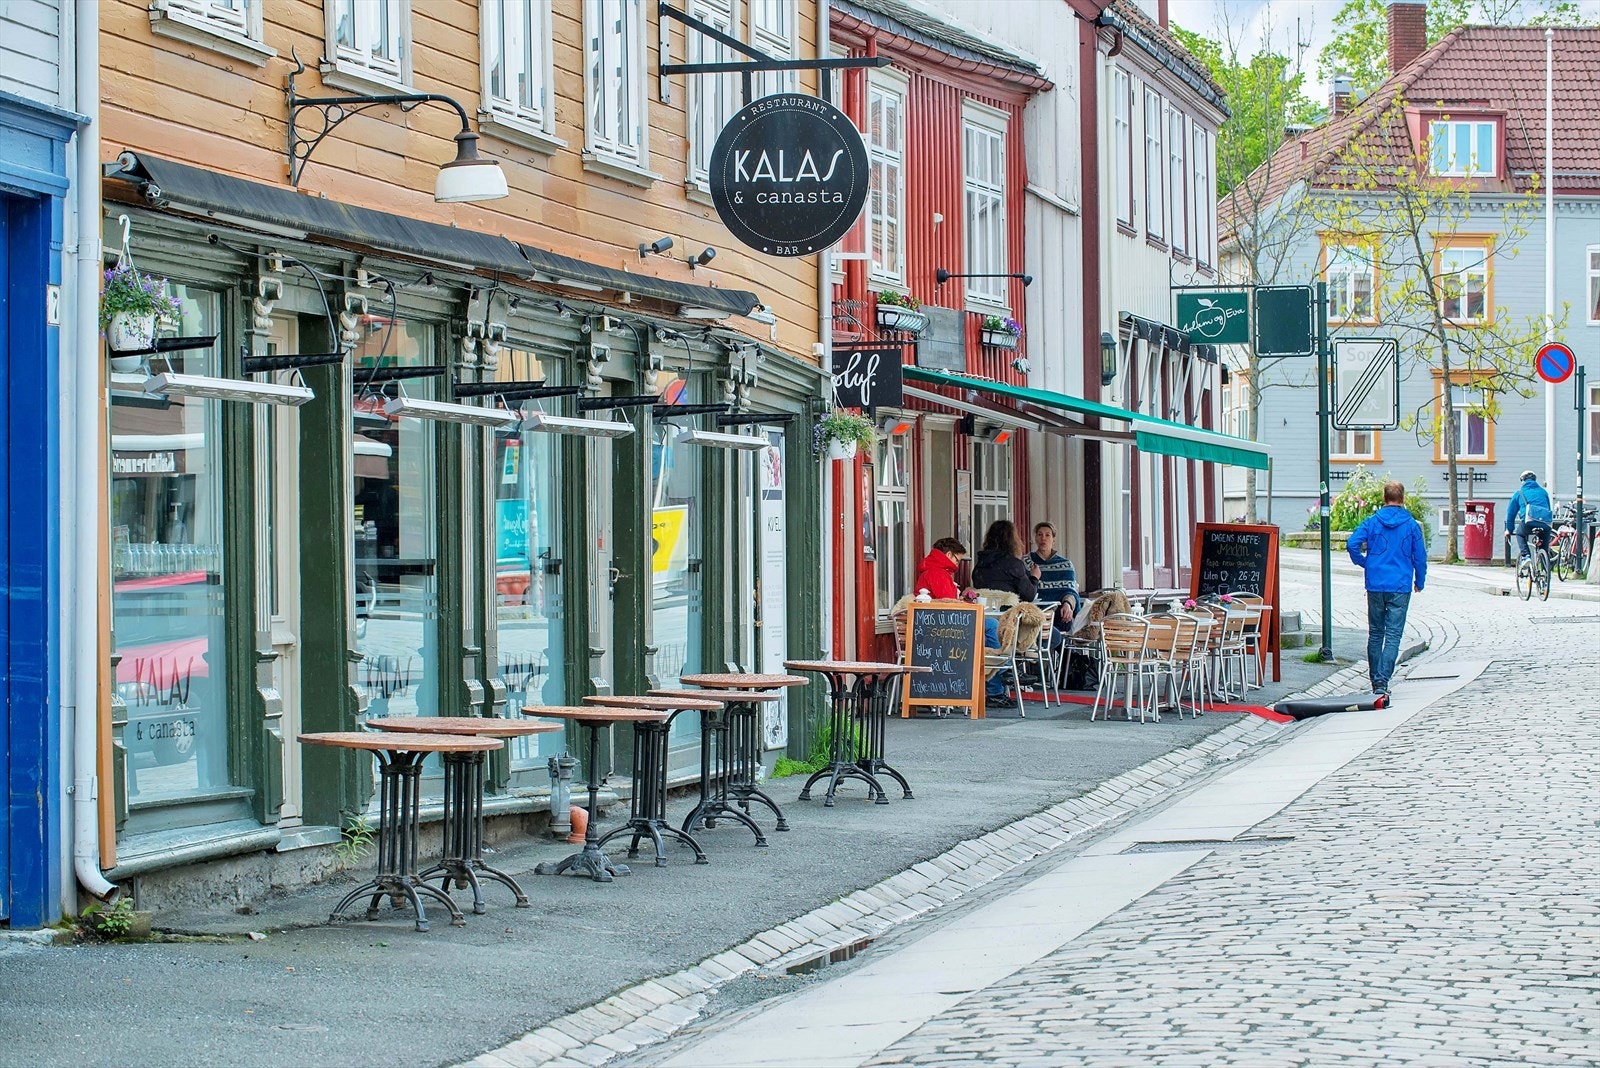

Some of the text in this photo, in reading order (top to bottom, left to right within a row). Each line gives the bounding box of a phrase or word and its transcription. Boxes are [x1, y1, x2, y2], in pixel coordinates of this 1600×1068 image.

[751, 98, 828, 115] RESTAURANT
[735, 149, 843, 183] KALAS
[734, 189, 844, 204] & canasta
[776, 246, 800, 255] BAR
[1214, 315, 1224, 325] og
[1226, 308, 1246, 319] Eva
[1211, 533, 1235, 543] DAGENS
[914, 611, 936, 626] Mens
[938, 611, 946, 626] vi
[914, 626, 924, 640] på
[916, 644, 968, 661] tilbyr vi 10%
[930, 659, 956, 675] på all
[136, 656, 194, 707] KALAS
[367, 655, 412, 699] KALAS
[912, 680, 948, 695] take-away
[136, 718, 196, 740] & canasta
